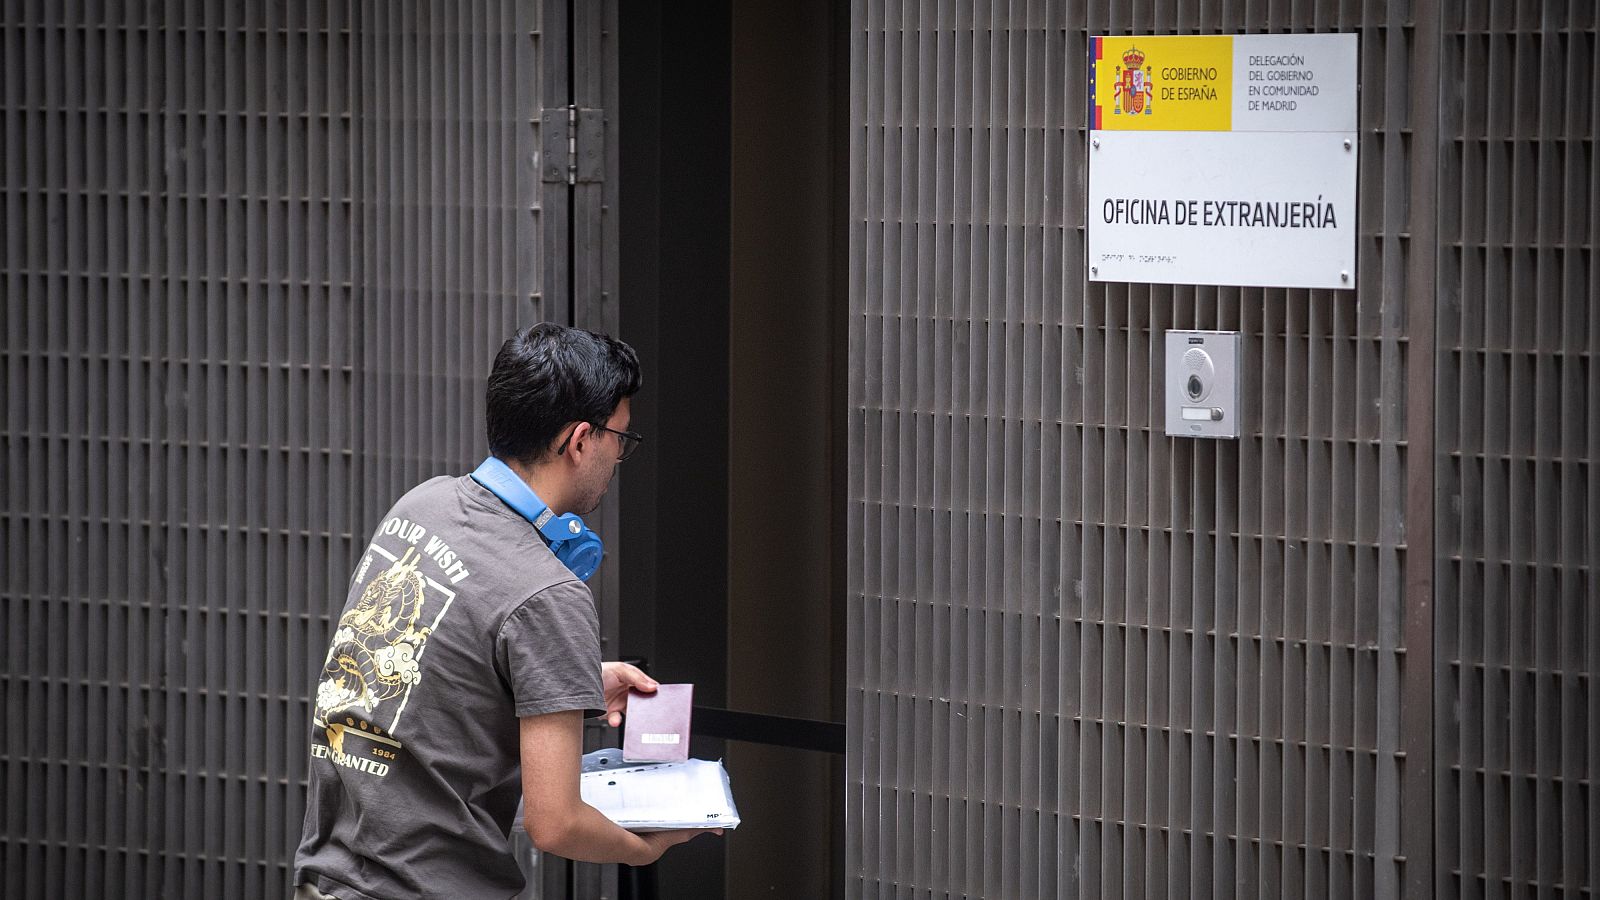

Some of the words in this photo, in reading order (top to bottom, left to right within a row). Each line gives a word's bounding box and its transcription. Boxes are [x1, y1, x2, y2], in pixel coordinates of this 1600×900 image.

[1249, 53, 1304, 66] DELEGACIÓN
[1161, 67, 1217, 81] GOBIERNO
[1249, 70, 1265, 81] DEL
[1267, 70, 1313, 81] GOBIERNO
[1161, 87, 1174, 100] DE
[1177, 84, 1217, 100] ESPAÑA
[1249, 86, 1262, 96] EN
[1263, 85, 1319, 96] COMUNIDAD
[1248, 100, 1260, 111] DE
[1262, 100, 1297, 111] MADRID
[1103, 198, 1170, 225] OFICINA
[1175, 200, 1198, 226] DE
[1203, 194, 1338, 229] EXTRANJERÍA
[423, 535, 469, 584] WISH
[372, 748, 396, 760] 1984
[331, 750, 389, 776] GRANTED
